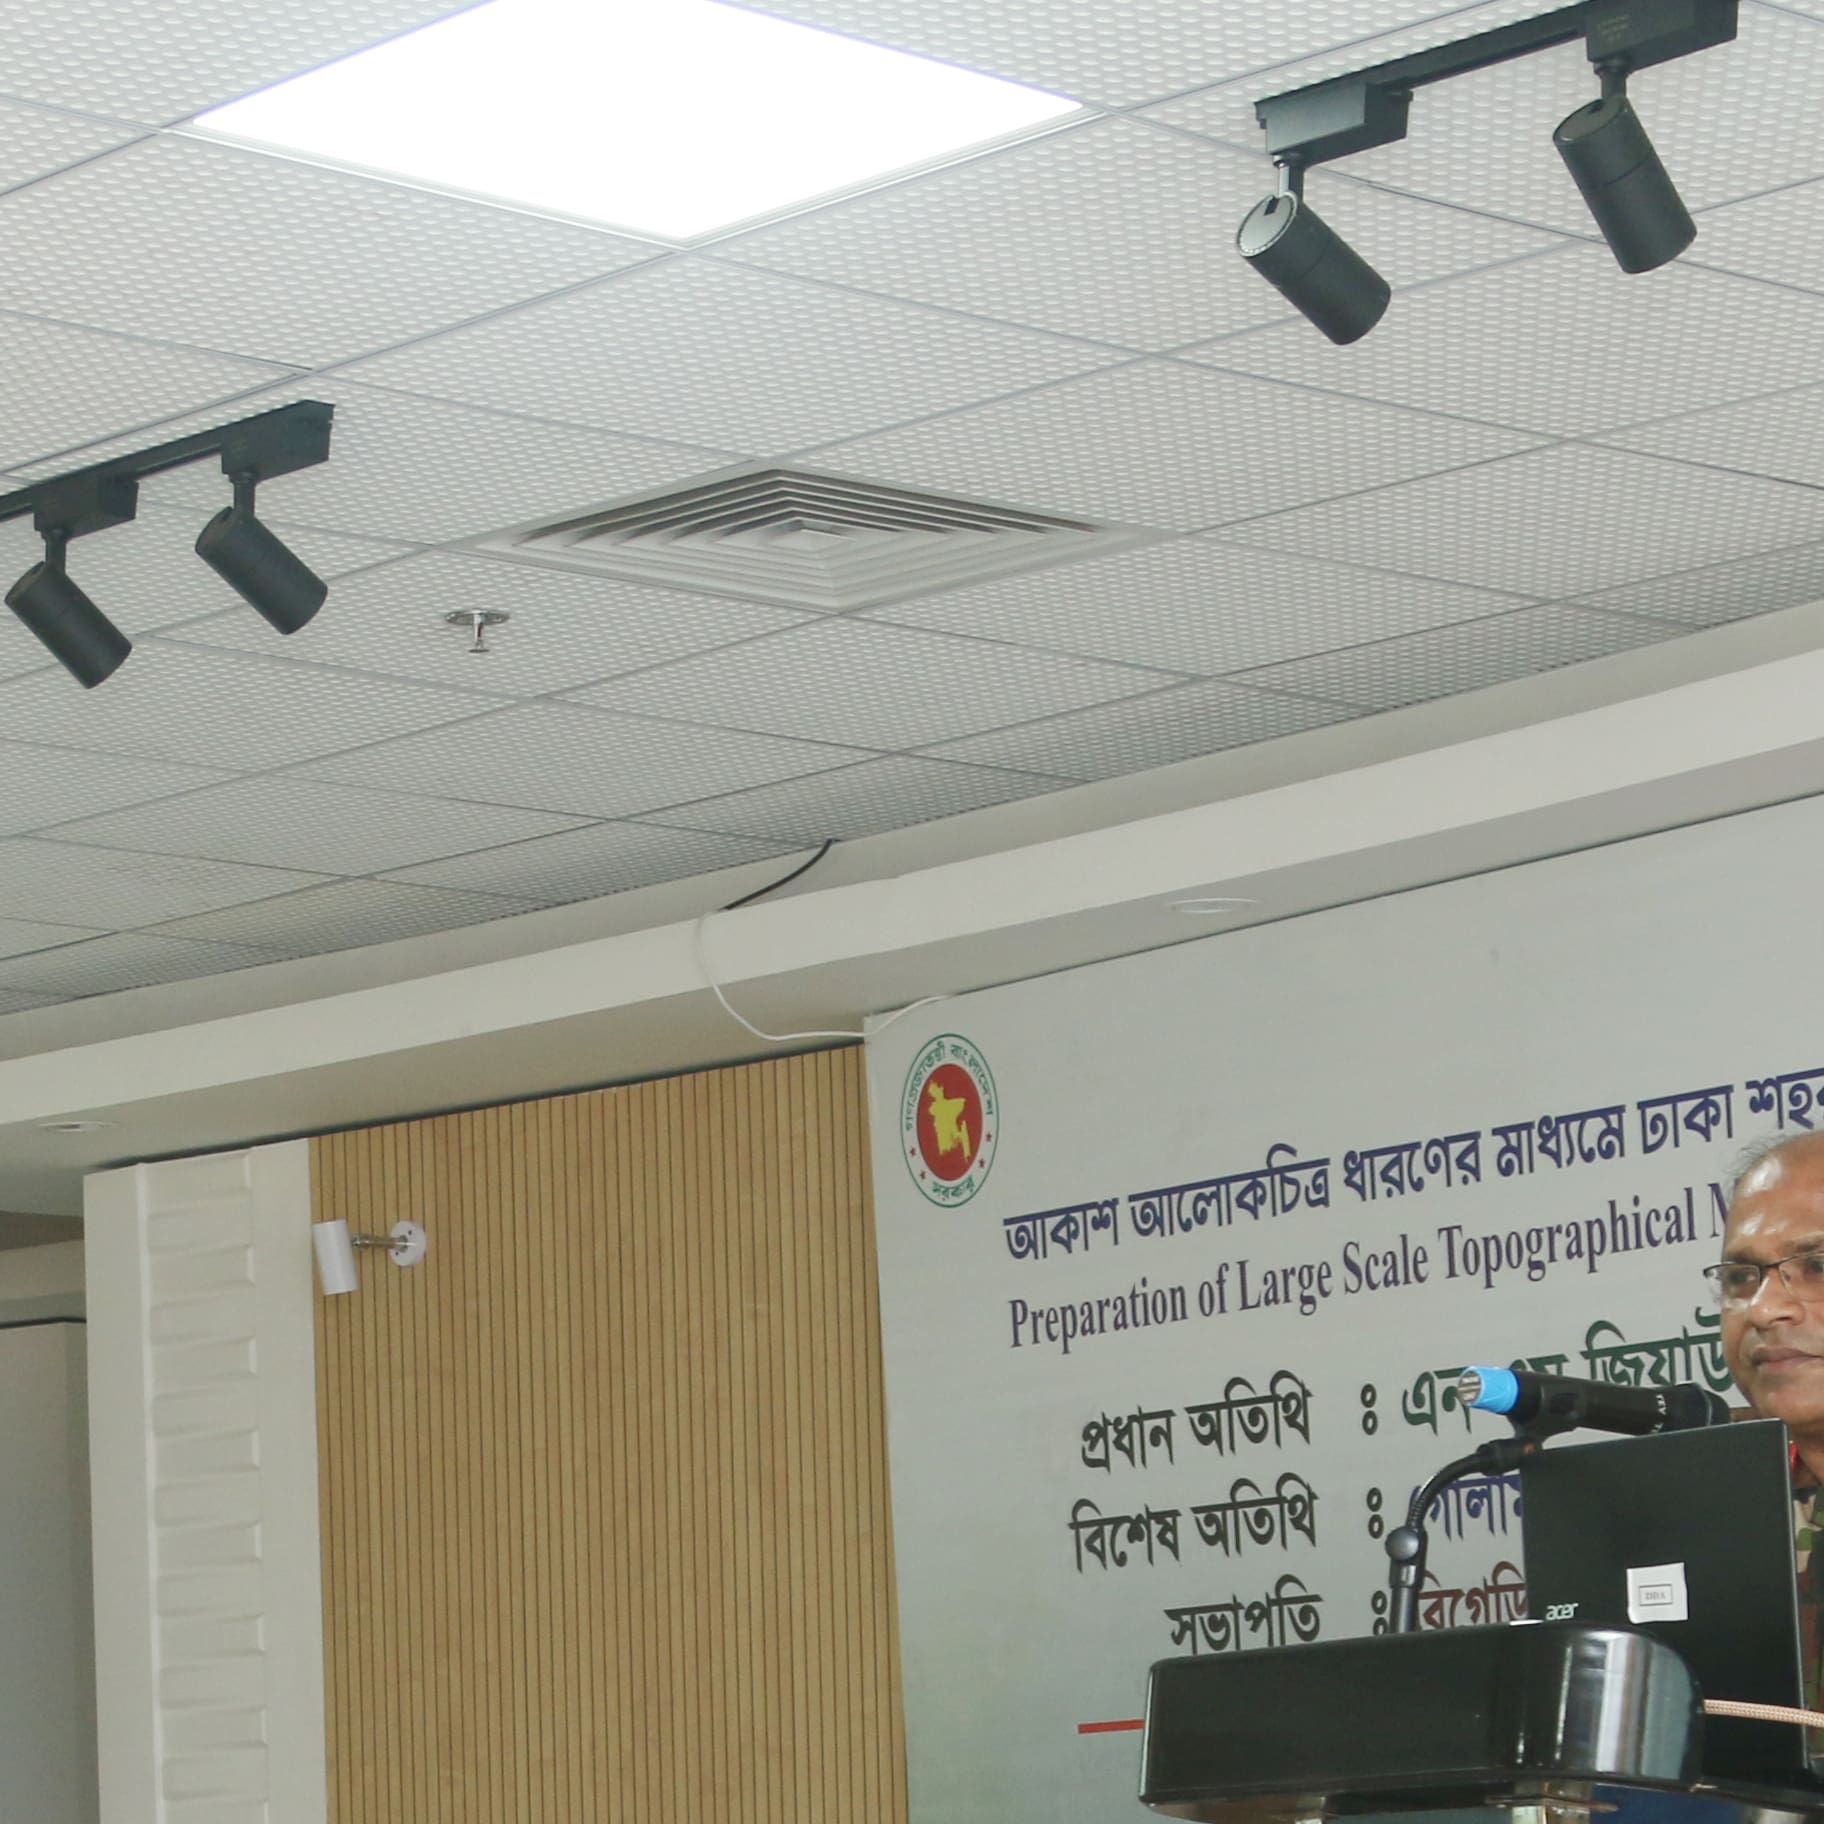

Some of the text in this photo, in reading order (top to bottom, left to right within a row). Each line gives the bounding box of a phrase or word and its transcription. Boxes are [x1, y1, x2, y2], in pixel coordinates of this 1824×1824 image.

[1003, 1198, 1119, 1260] আকাশ
[1128, 1143, 1330, 1242] আলোকচিত্র
[1343, 1131, 1481, 1202] ধারণের
[1491, 1104, 1626, 1177] মাধ্যমে
[1636, 1084, 1734, 1154] ঢাকা
[1009, 1277, 1188, 1355] Preparation
[1198, 1263, 1229, 1317] of
[1236, 1260, 1332, 1316] Large
[1343, 1234, 1428, 1294] Scale
[1437, 1187, 1697, 1289] Topographical
[1081, 1406, 1176, 1474] প্রধান
[1184, 1370, 1313, 1456] অতিথি
[1067, 1498, 1182, 1573] বিশেষ
[1190, 1472, 1319, 1557] অতিথি
[1162, 1573, 1323, 1652] সভাপতি
[1546, 1602, 1580, 1620] acer
